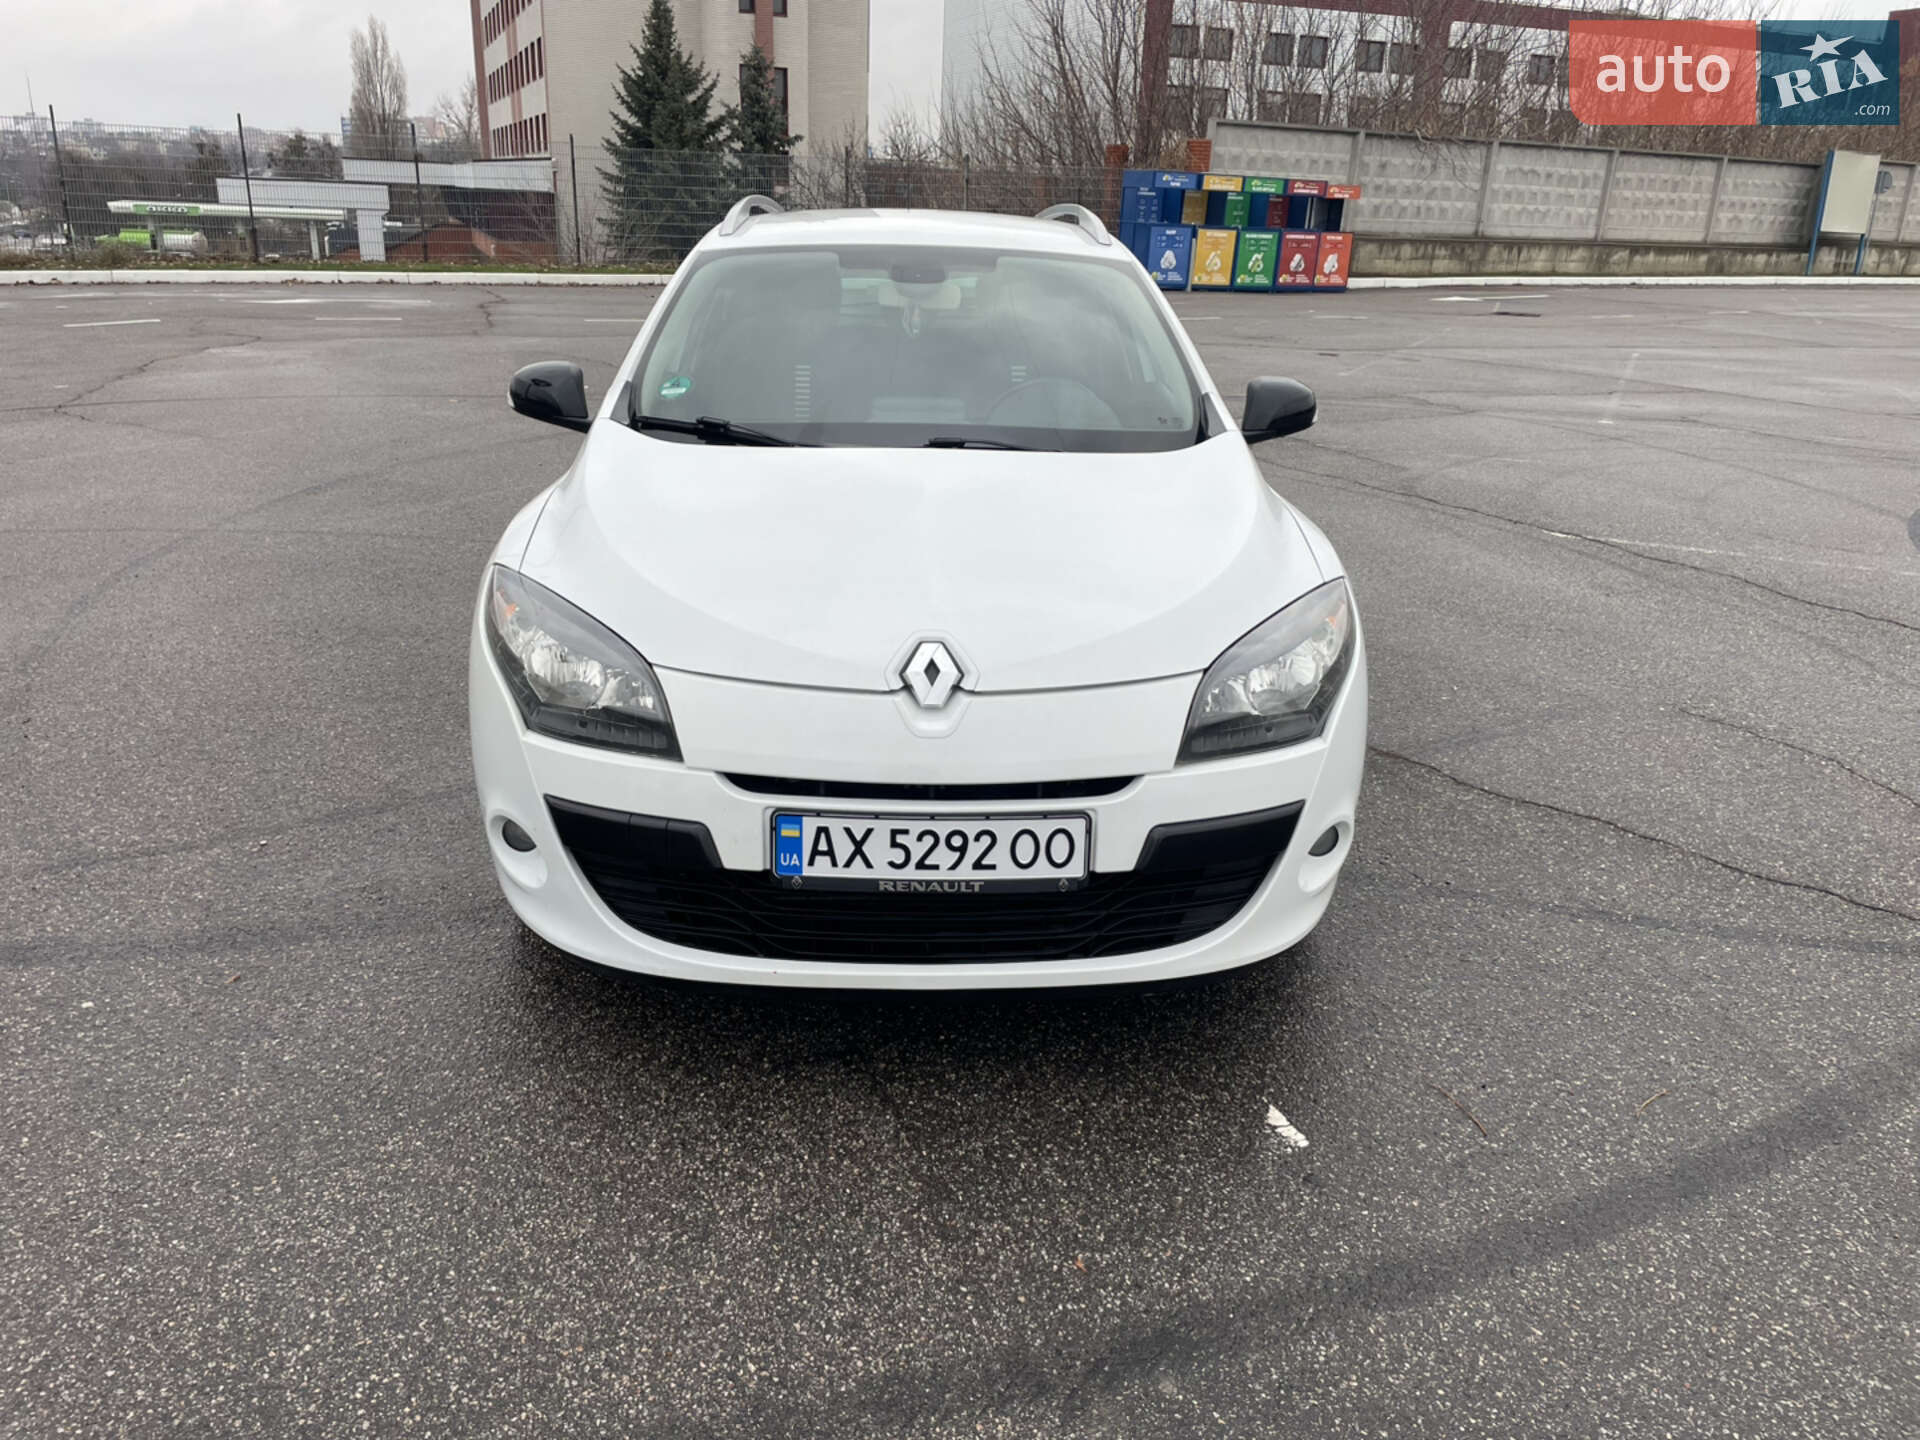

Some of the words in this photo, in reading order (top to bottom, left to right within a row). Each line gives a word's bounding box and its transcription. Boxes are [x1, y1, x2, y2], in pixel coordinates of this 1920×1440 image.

[807, 825, 875, 869] AX
[887, 828, 998, 870] 5292
[780, 852, 801, 867] UA
[878, 880, 985, 893] RENAULT
